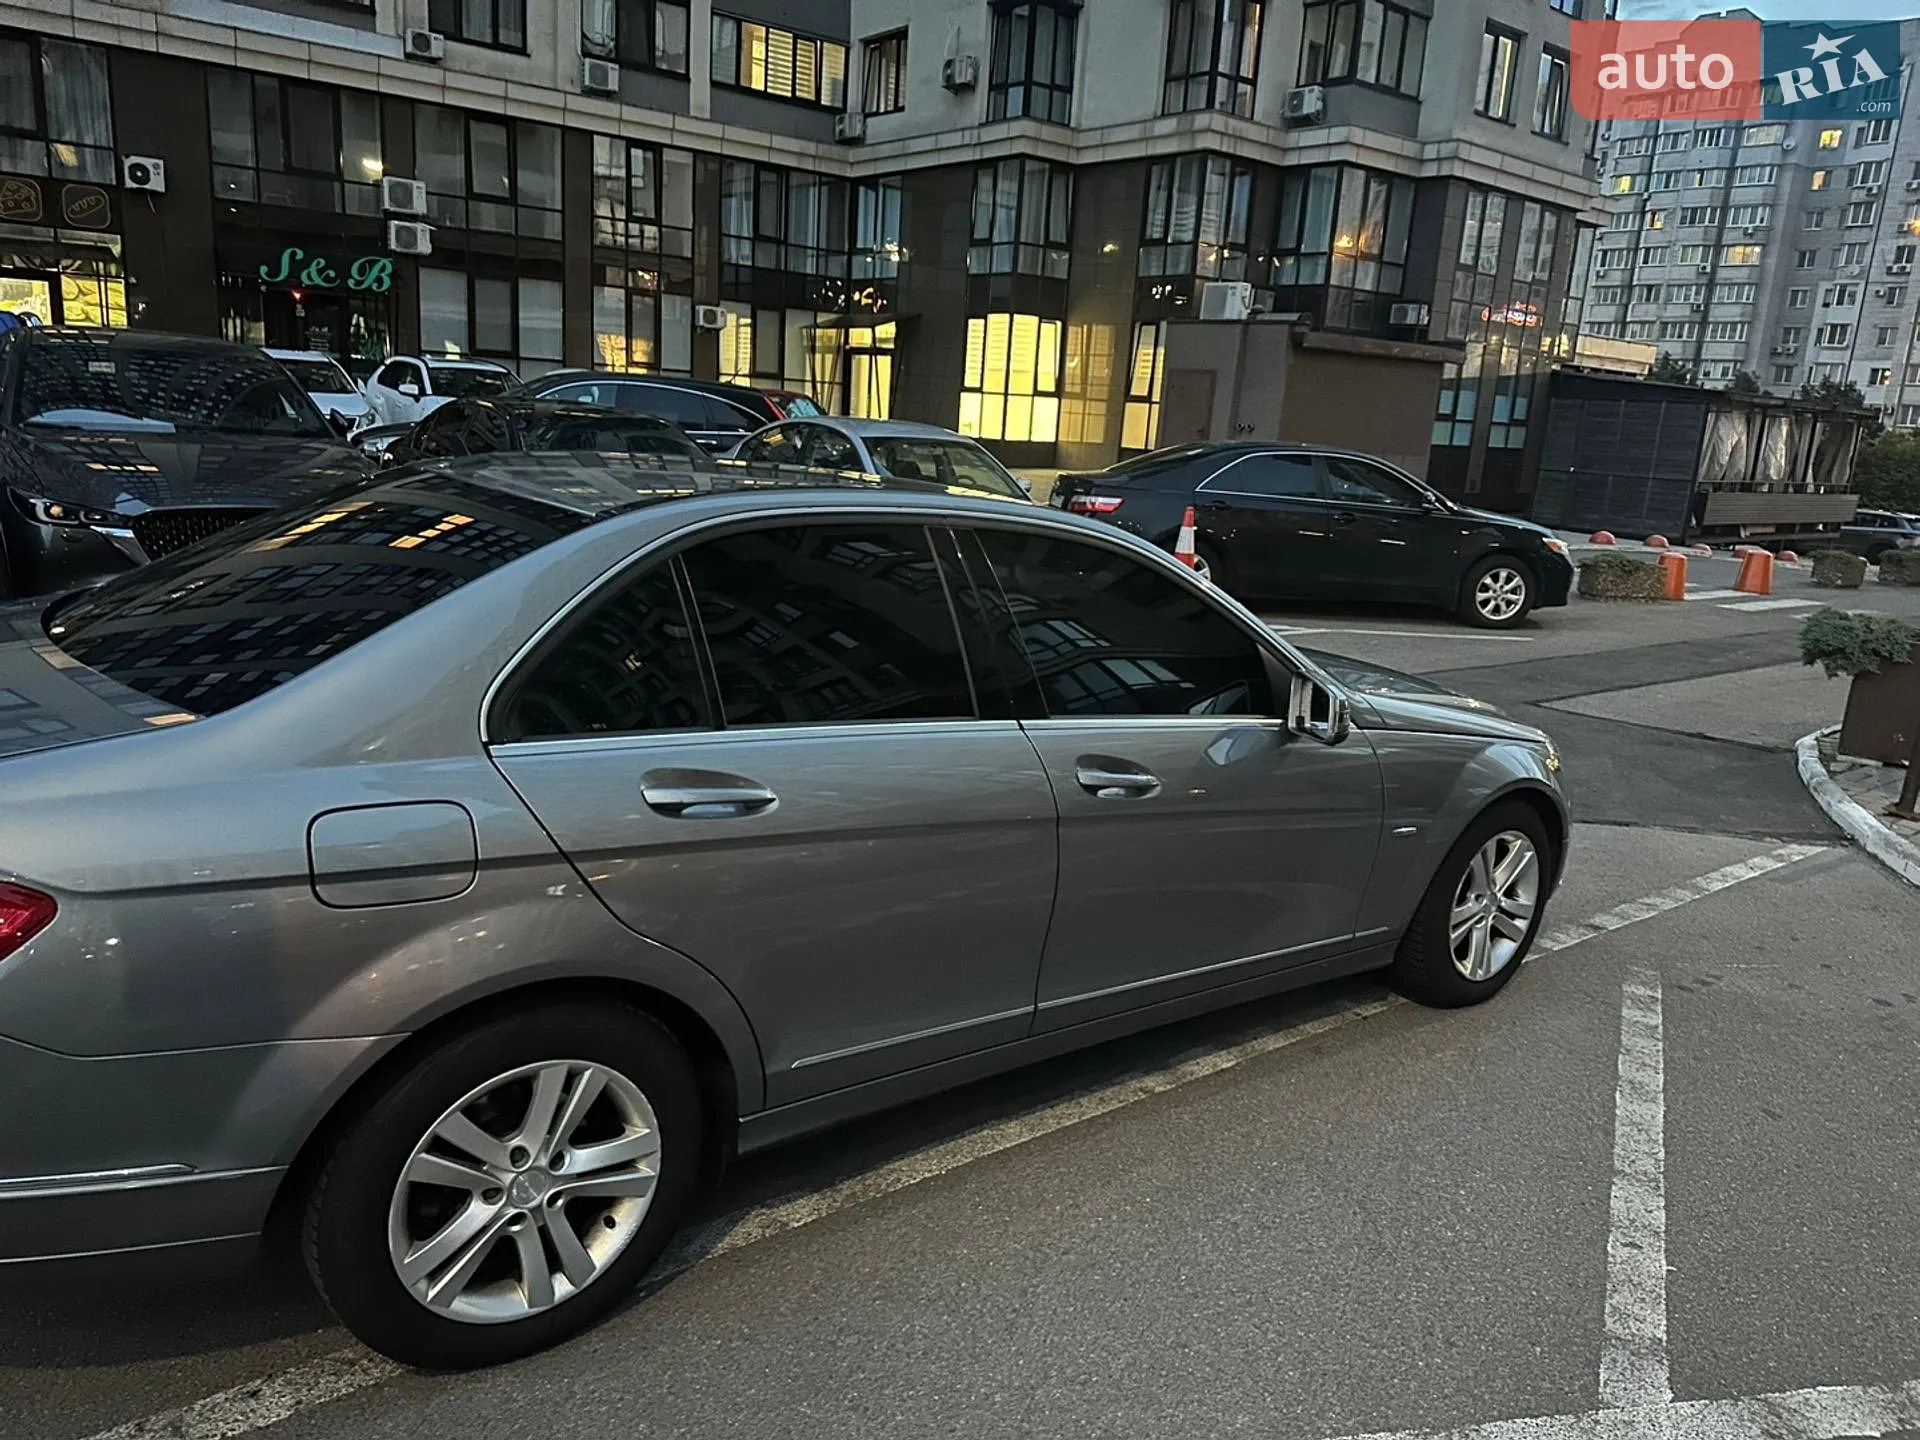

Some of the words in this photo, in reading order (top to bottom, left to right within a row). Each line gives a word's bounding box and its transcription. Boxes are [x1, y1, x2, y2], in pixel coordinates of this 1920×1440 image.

[260, 248, 303, 281] S
[301, 258, 340, 288] &
[347, 255, 394, 292] B
